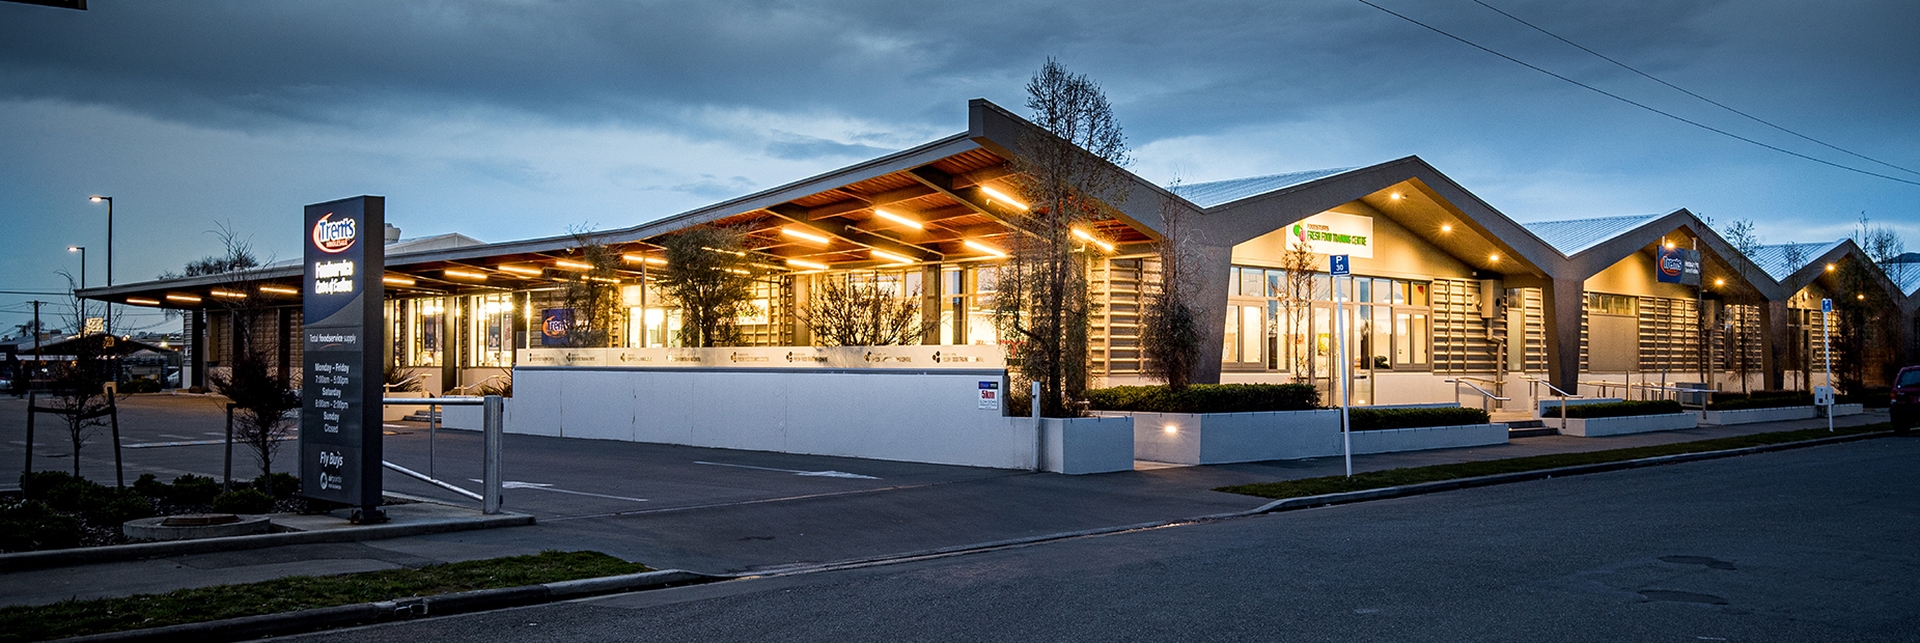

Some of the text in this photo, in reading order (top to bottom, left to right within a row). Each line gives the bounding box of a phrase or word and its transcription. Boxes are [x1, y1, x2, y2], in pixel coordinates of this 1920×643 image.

[319, 219, 355, 241] Trents
[1307, 230, 1367, 246] FRESH FOOD TRAINING CENTRE
[1336, 255, 1343, 264] P
[1663, 256, 1682, 270] Trents
[309, 333, 357, 344] Total foodservice supply
[314, 363, 332, 373] Monday
[335, 363, 350, 374] Friday
[322, 387, 342, 398] Saturday
[981, 390, 995, 399] 5km
[323, 411, 340, 422] Sunday
[323, 423, 339, 433] Closed
[320, 451, 344, 468] Fly Buys
